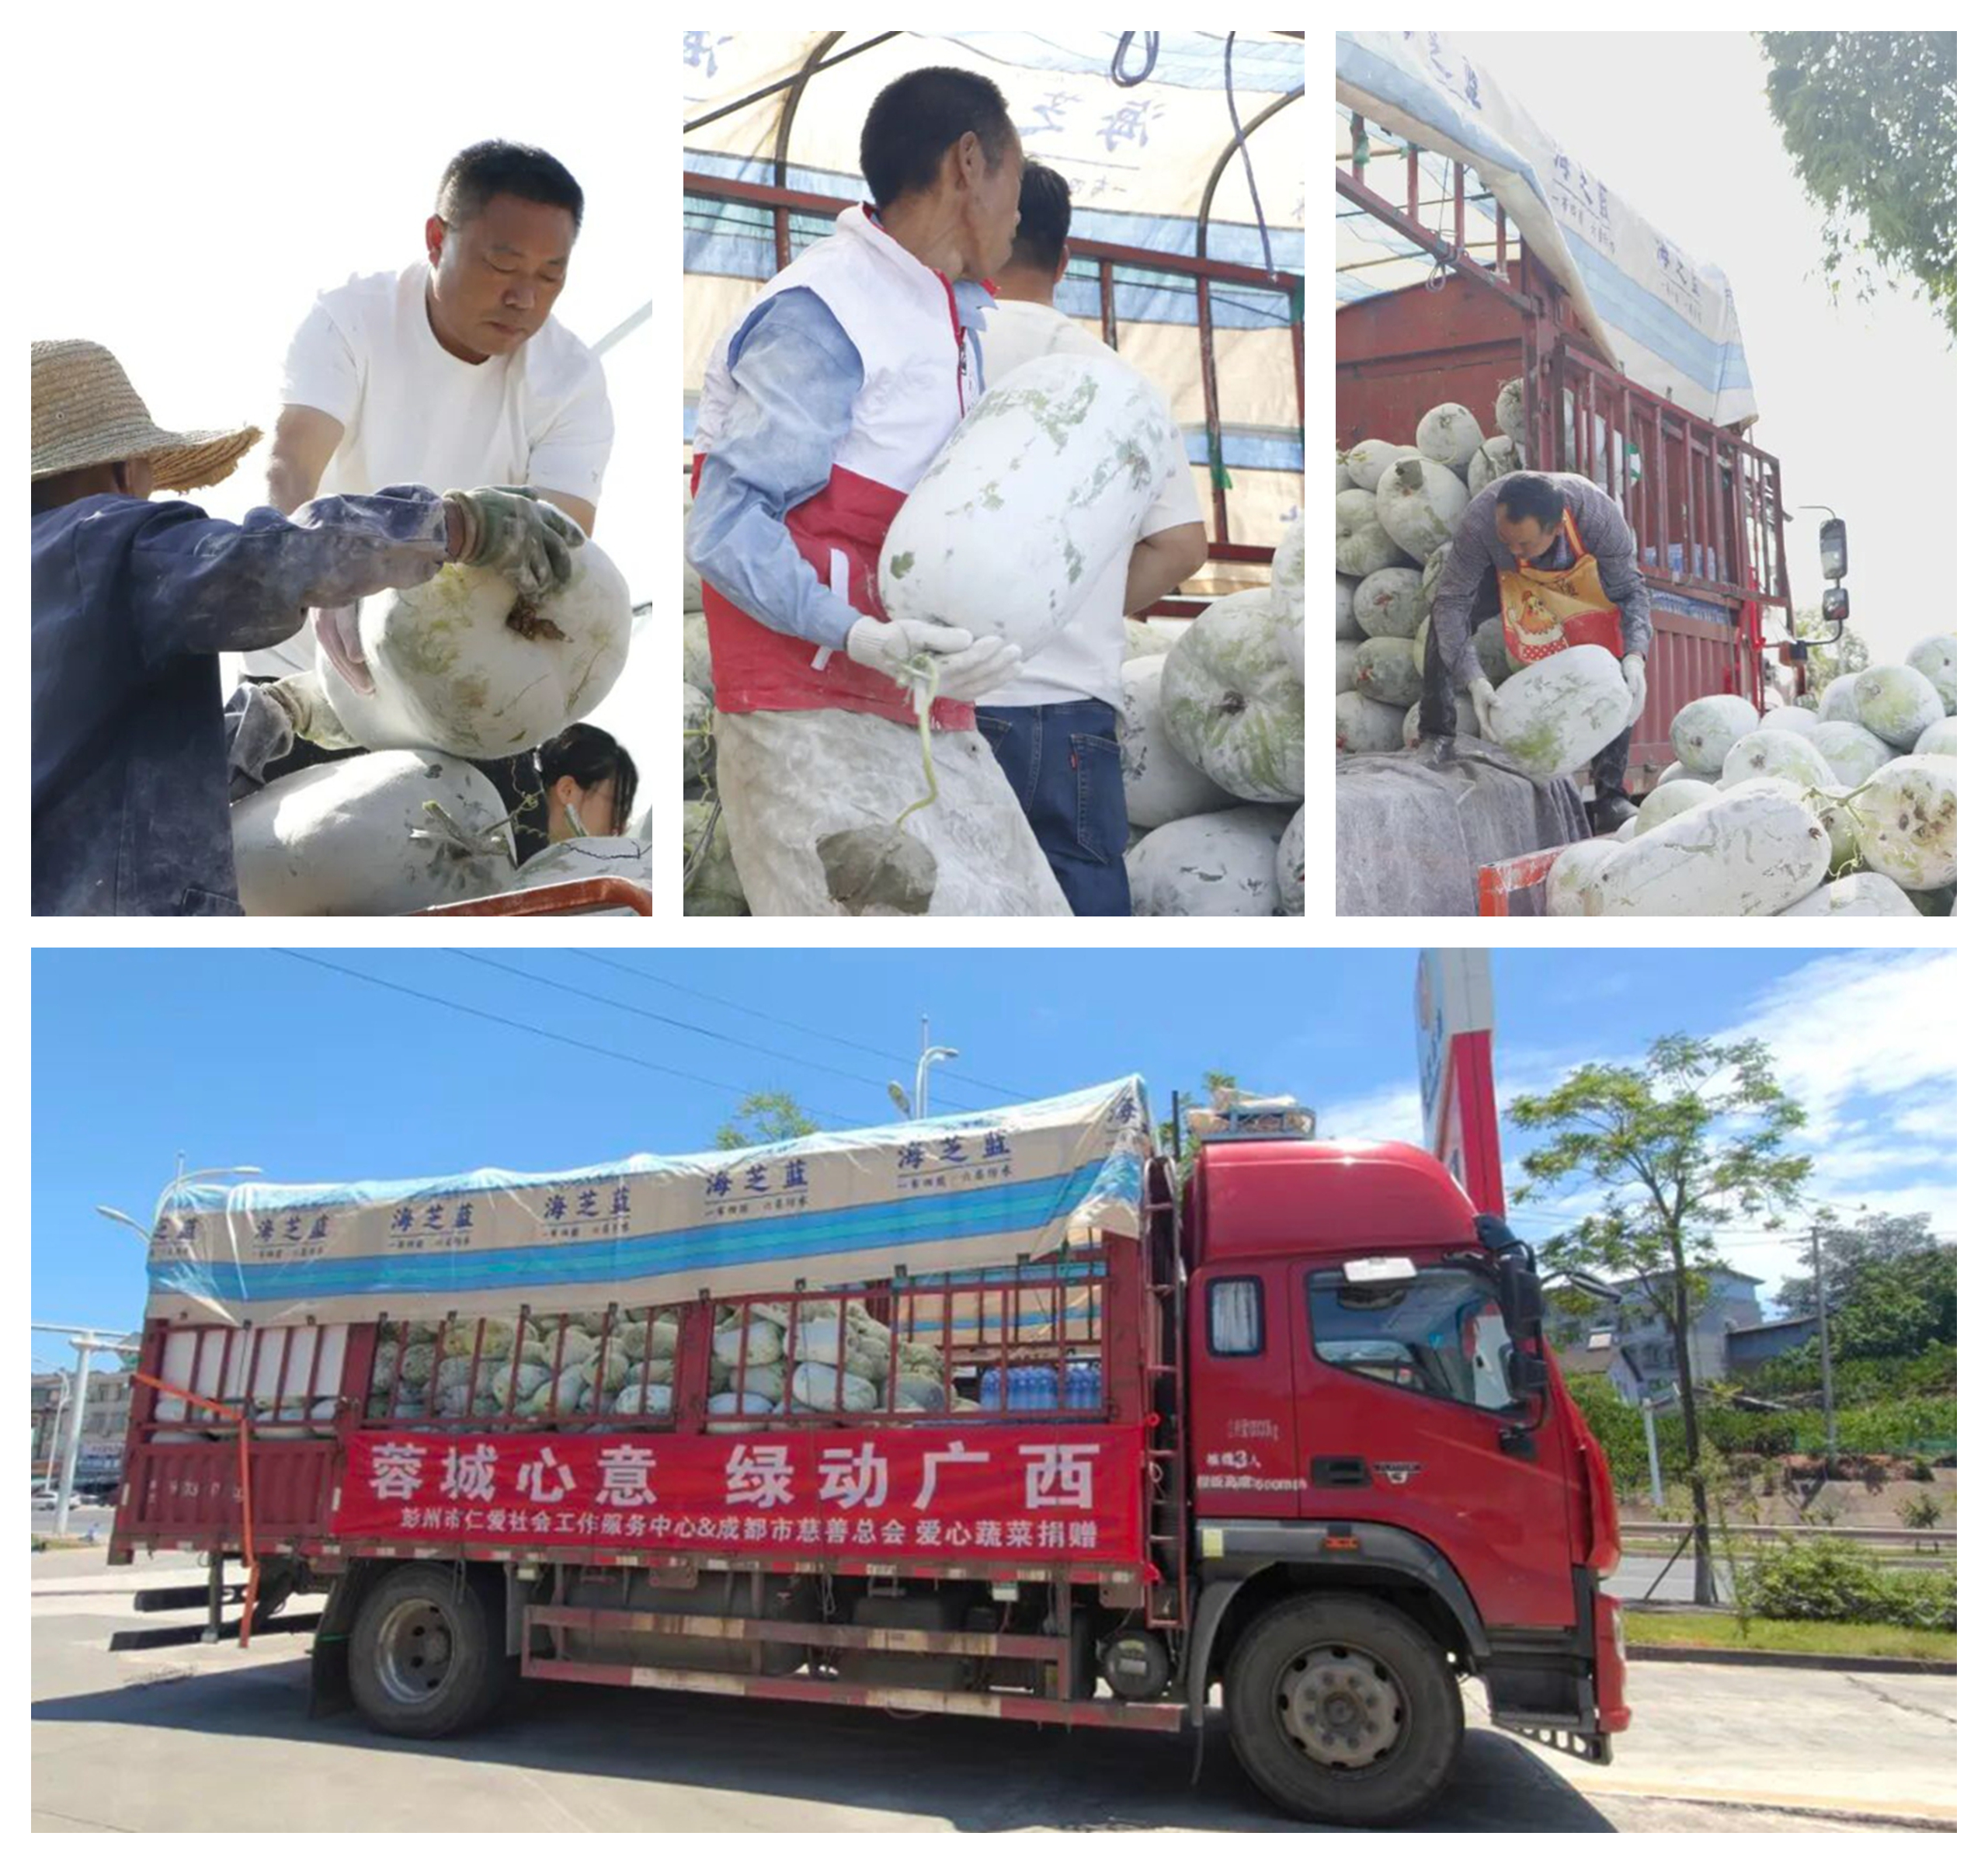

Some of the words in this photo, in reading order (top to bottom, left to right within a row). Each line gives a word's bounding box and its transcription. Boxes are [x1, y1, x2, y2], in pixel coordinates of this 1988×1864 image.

[898, 1129, 1011, 1169] 海芝蓝
[706, 1158, 808, 1197] 海芝蓝
[390, 1202, 474, 1232] 海芝蓝
[544, 1184, 631, 1220] 海芝蓝
[369, 1441, 657, 1507] 蓉城心意
[725, 1440, 1101, 1511] 绿动广西
[400, 1507, 907, 1544] 彭州市仁爱社会工作服务中心&成都市慈善总会
[916, 1519, 1098, 1549] 爱心蔬菜捐赠
